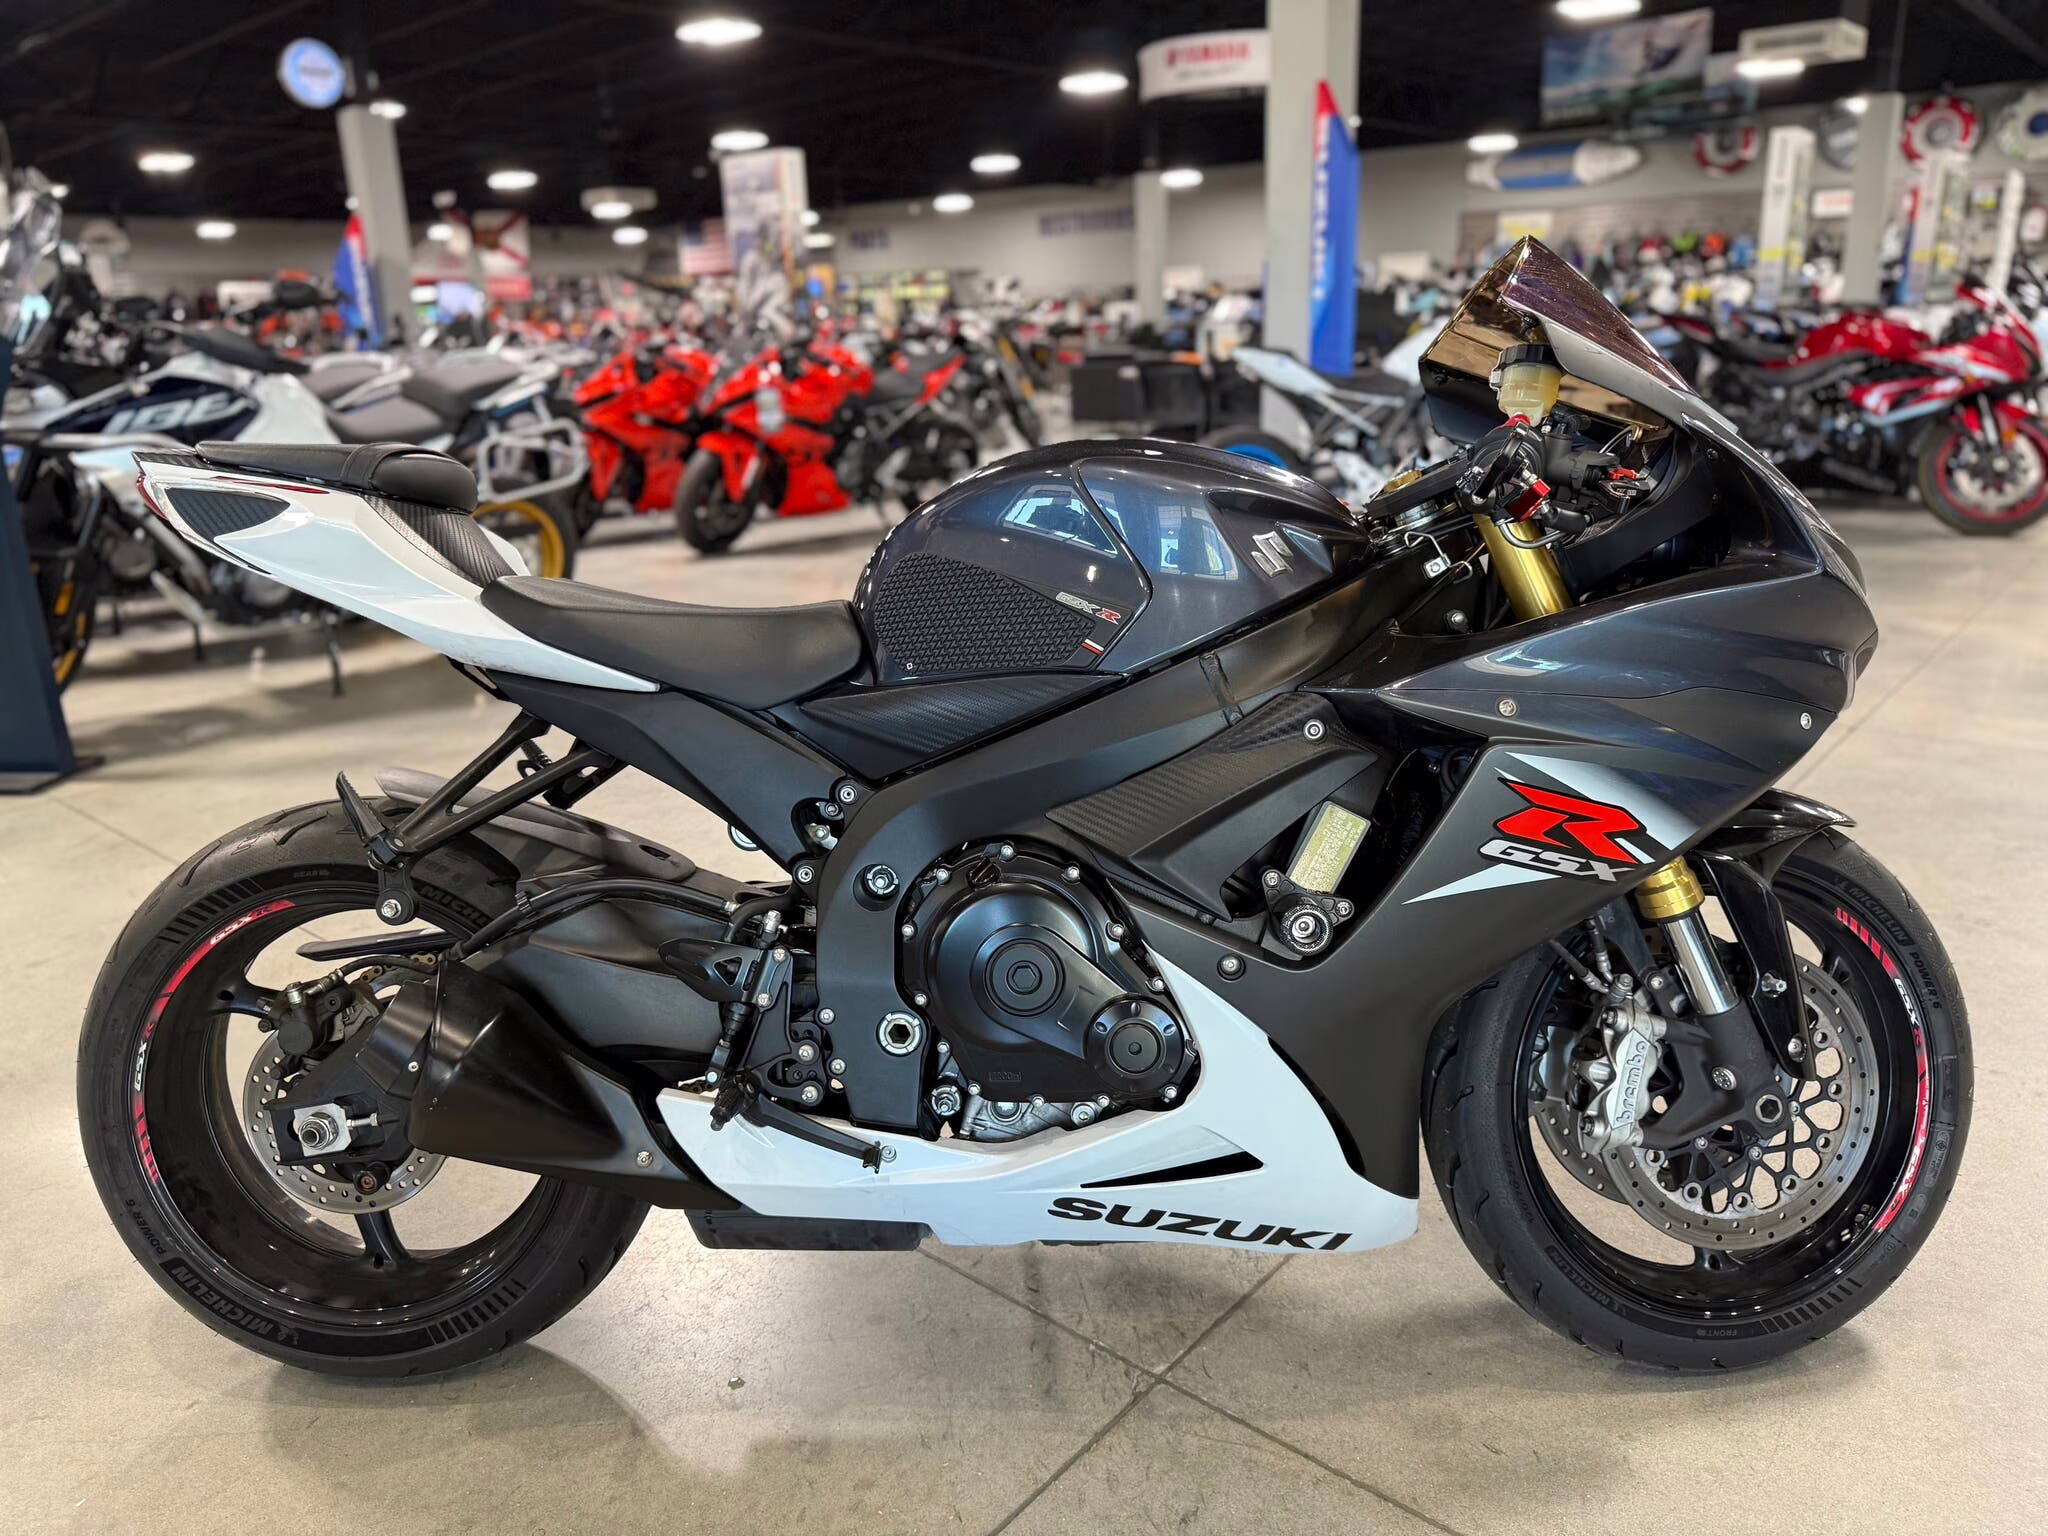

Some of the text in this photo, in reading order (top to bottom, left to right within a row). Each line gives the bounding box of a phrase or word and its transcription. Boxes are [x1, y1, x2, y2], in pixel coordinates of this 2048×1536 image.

[1479, 839, 1637, 882] GSX
[1847, 887, 1909, 942] MICHELIN
[1909, 951, 1938, 999] POWER
[1615, 1040, 1648, 1123] brembo
[125, 1198, 167, 1255] POWER 6
[1047, 1196, 1354, 1251] SUZUKI
[171, 1265, 274, 1336] MICHELIN
[1549, 1249, 1610, 1305] MICHELIN
